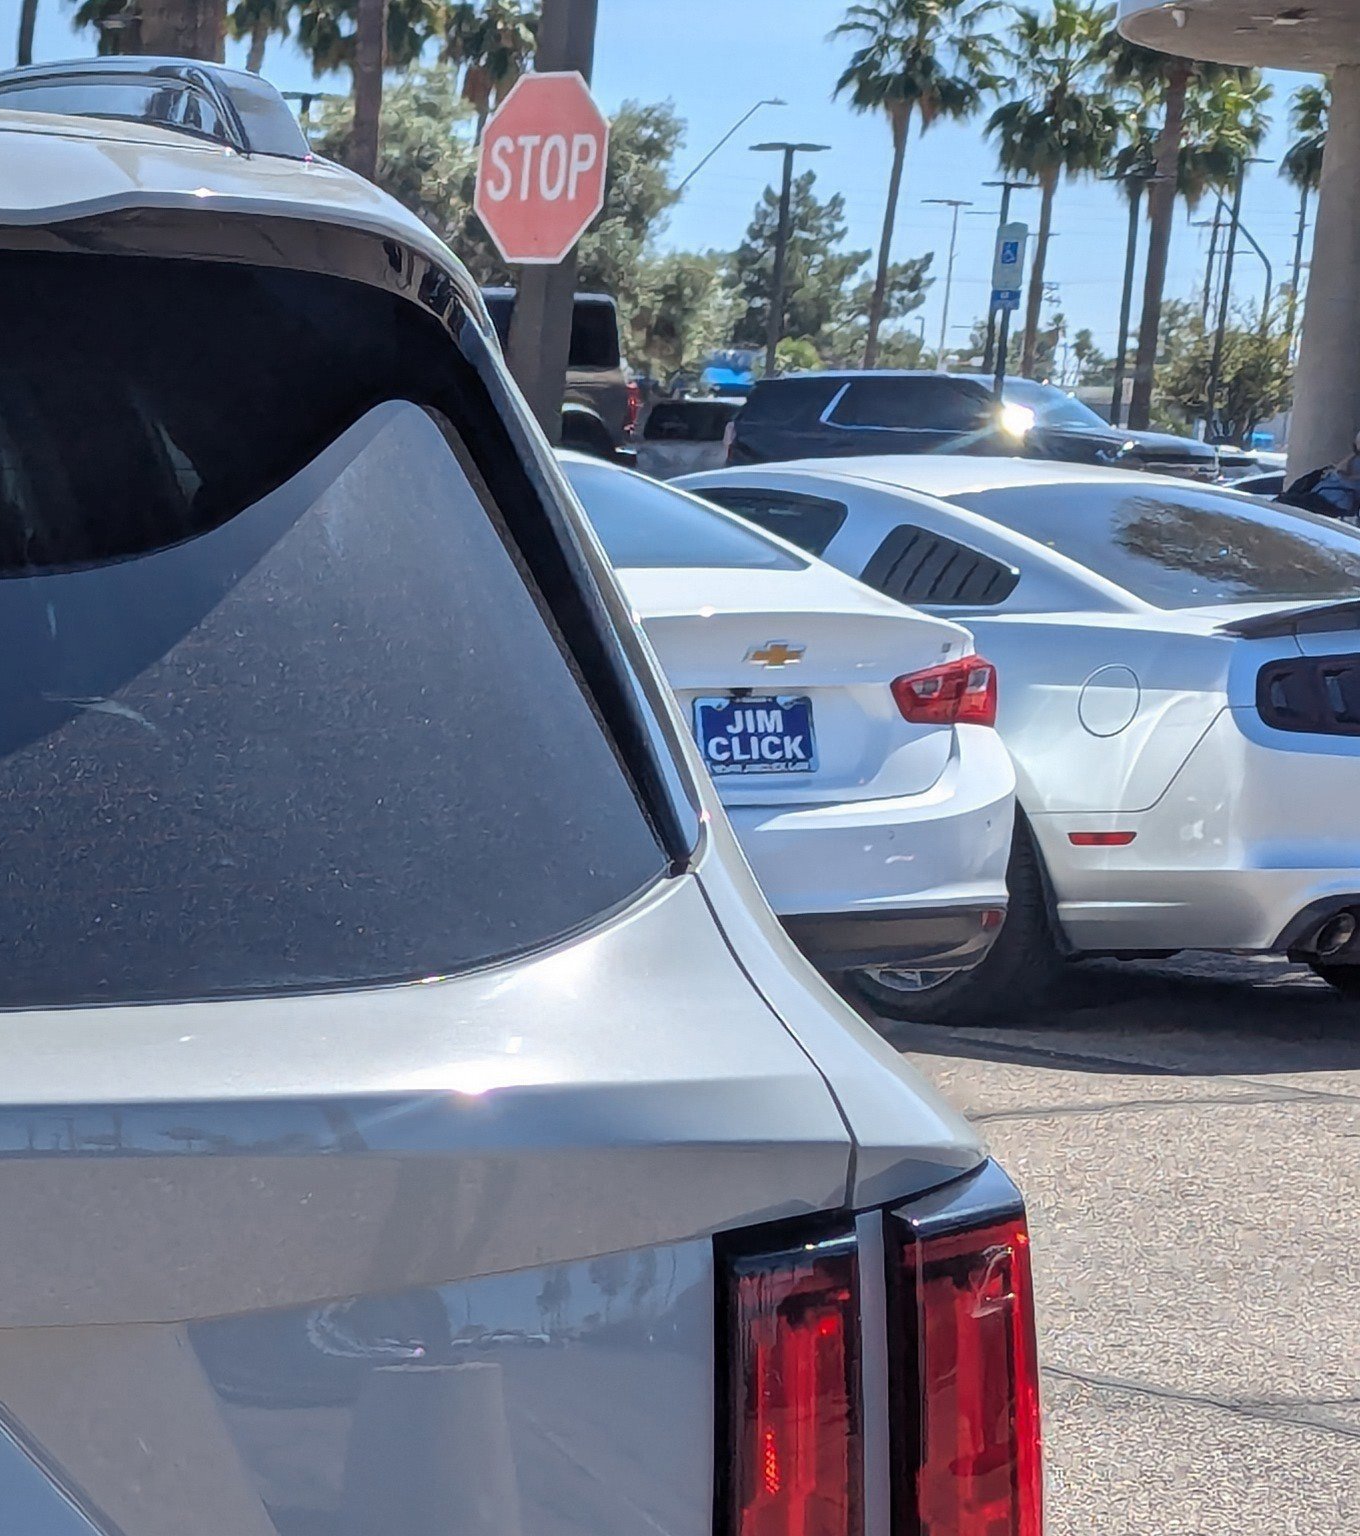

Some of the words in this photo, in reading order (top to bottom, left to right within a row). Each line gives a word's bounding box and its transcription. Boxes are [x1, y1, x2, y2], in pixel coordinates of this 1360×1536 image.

[486, 134, 597, 201] STOP
[726, 709, 784, 734] JIM
[708, 735, 806, 761] CLICK
